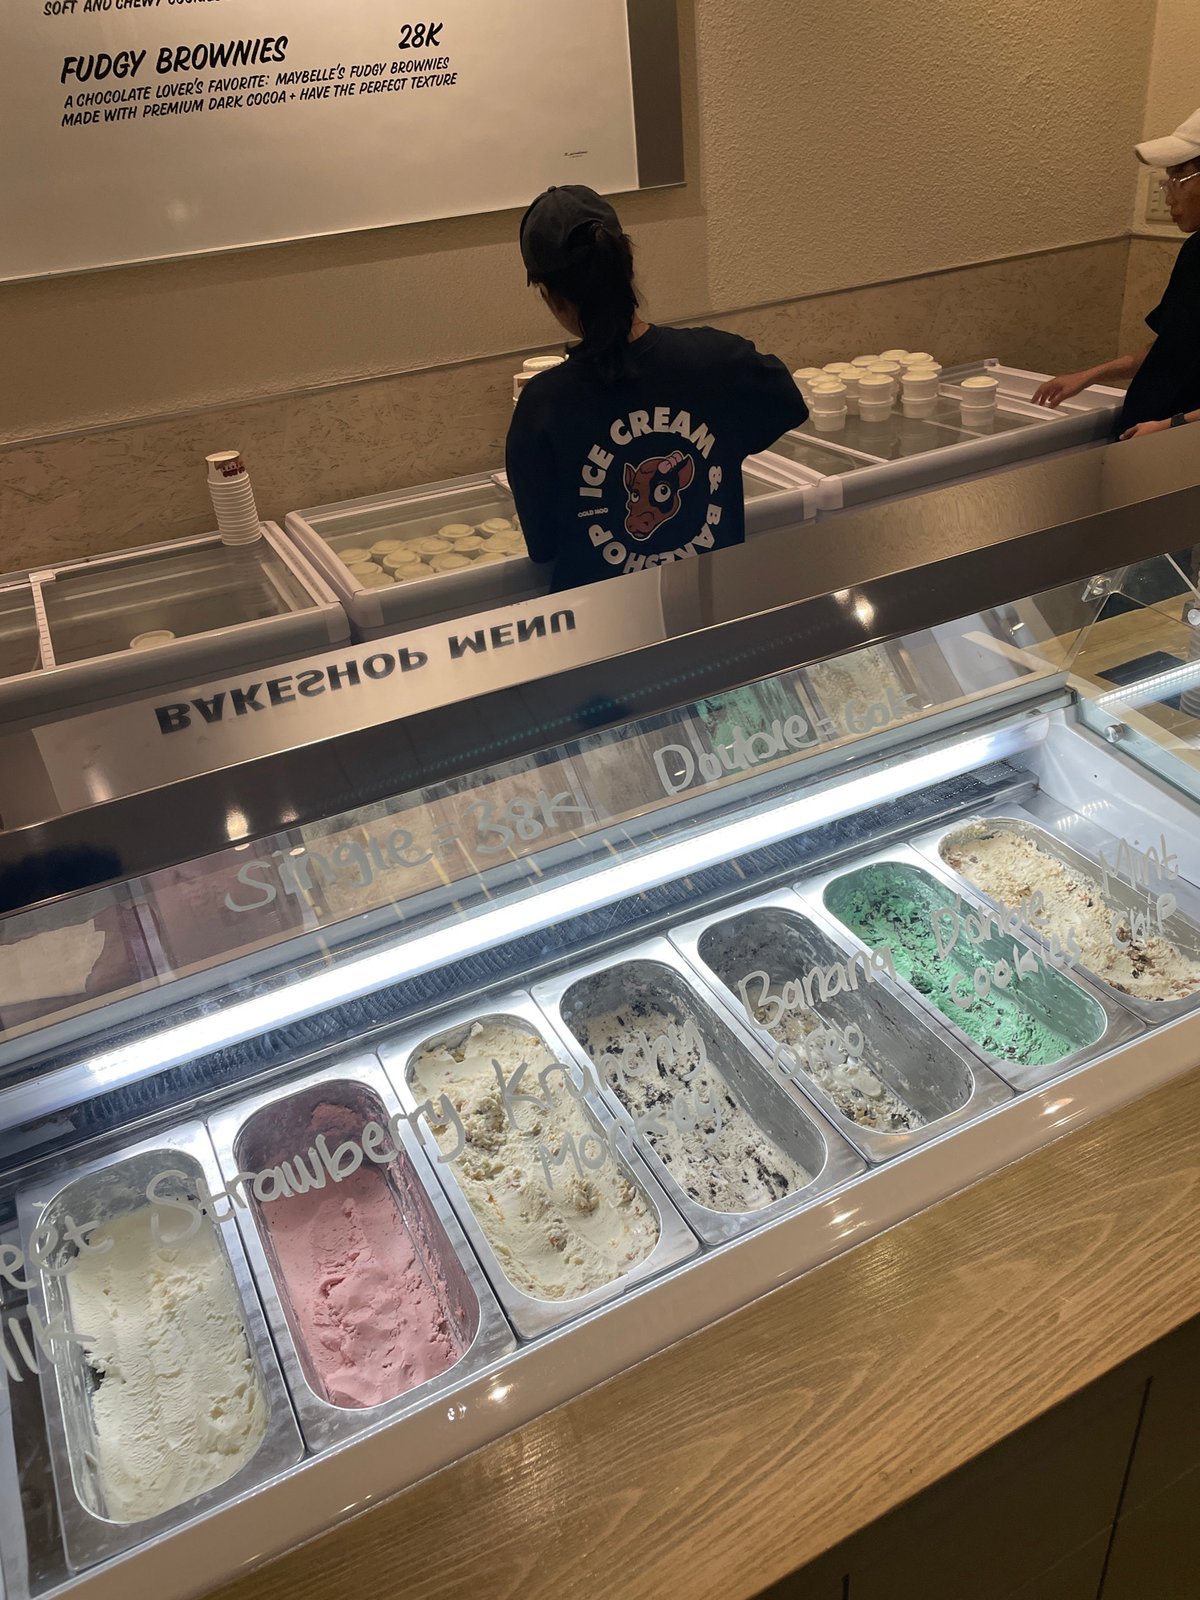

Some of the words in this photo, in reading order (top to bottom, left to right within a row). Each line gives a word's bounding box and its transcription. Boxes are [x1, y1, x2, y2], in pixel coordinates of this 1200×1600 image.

[43, 0, 78, 15] SOFT
[83, 0, 112, 12] AND
[60, 49, 147, 84] FUDGY
[156, 36, 288, 74] BROWNIES
[398, 22, 443, 49] 28K
[64, 95, 73, 109] A
[76, 86, 151, 107] CHOCOLATE
[156, 77, 204, 99] LOVER'S
[208, 74, 270, 93] FAVORITE:
[275, 63, 346, 86] MAYBELLE'S
[350, 63, 387, 79] FUDGY
[390, 56, 450, 75] BROWNIES
[61, 110, 100, 127] MADE
[104, 106, 138, 122] WITH
[143, 98, 204, 118] PREMIUM
[208, 95, 243, 111] DARK
[246, 90, 286, 107] COCOA
[289, 92, 297, 101] +
[299, 86, 331, 101] HAVE
[334, 82, 356, 98] THE
[359, 78, 408, 95] PERFECT
[411, 72, 458, 89] TEXTURE
[579, 444, 615, 498] ICE
[609, 406, 716, 460] CREAM
[708, 465, 723, 496] &
[225, 828, 434, 912] Single
[737, 946, 897, 1031] Banana
[145, 1093, 466, 1248] Strawberry
